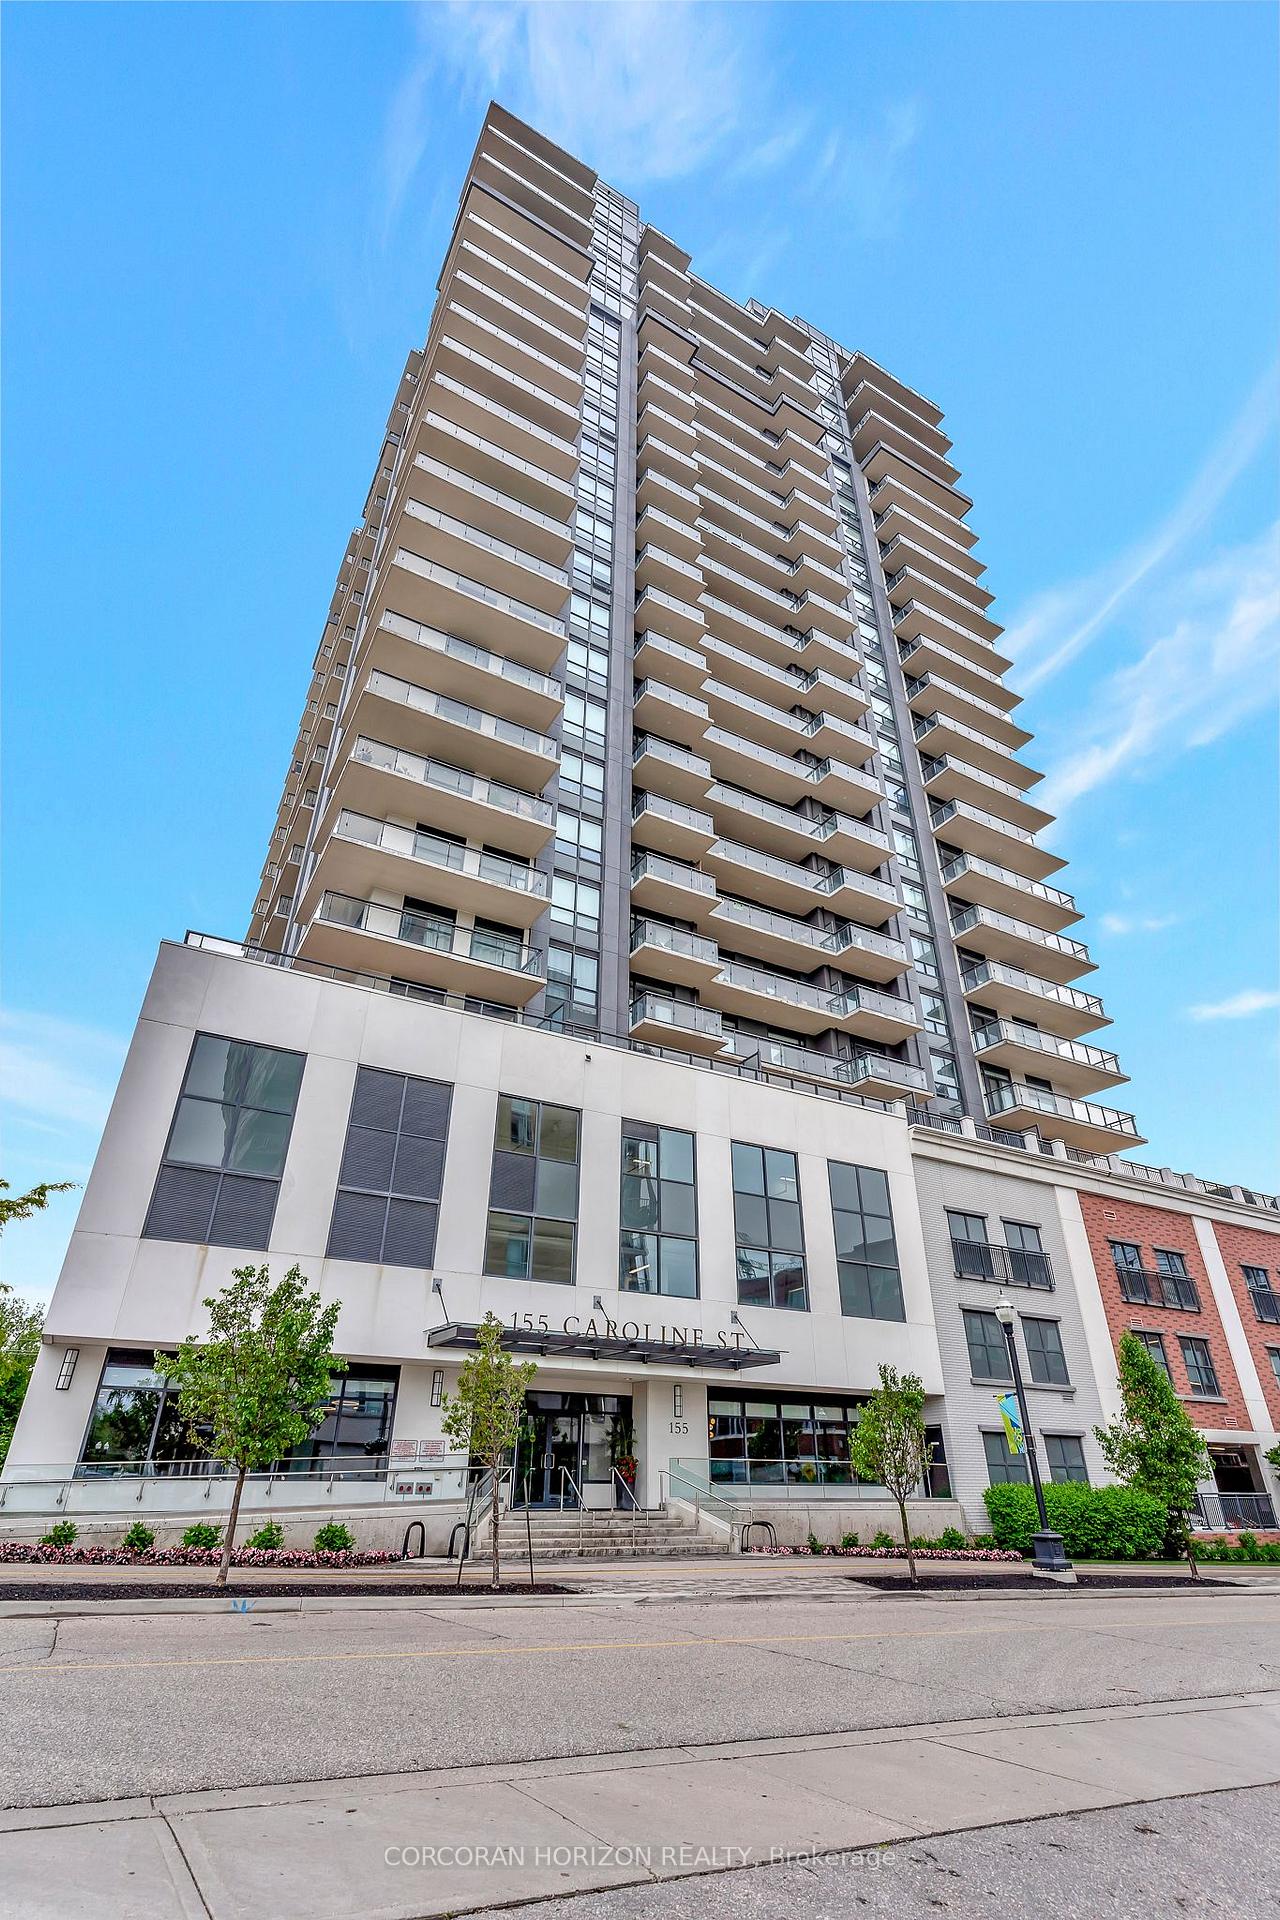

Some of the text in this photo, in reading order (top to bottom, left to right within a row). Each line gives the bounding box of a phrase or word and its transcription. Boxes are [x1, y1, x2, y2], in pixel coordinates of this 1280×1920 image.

[510, 1312, 549, 1334] 155
[563, 1316, 704, 1347] CAROLINE
[669, 1422, 689, 1435] 155
